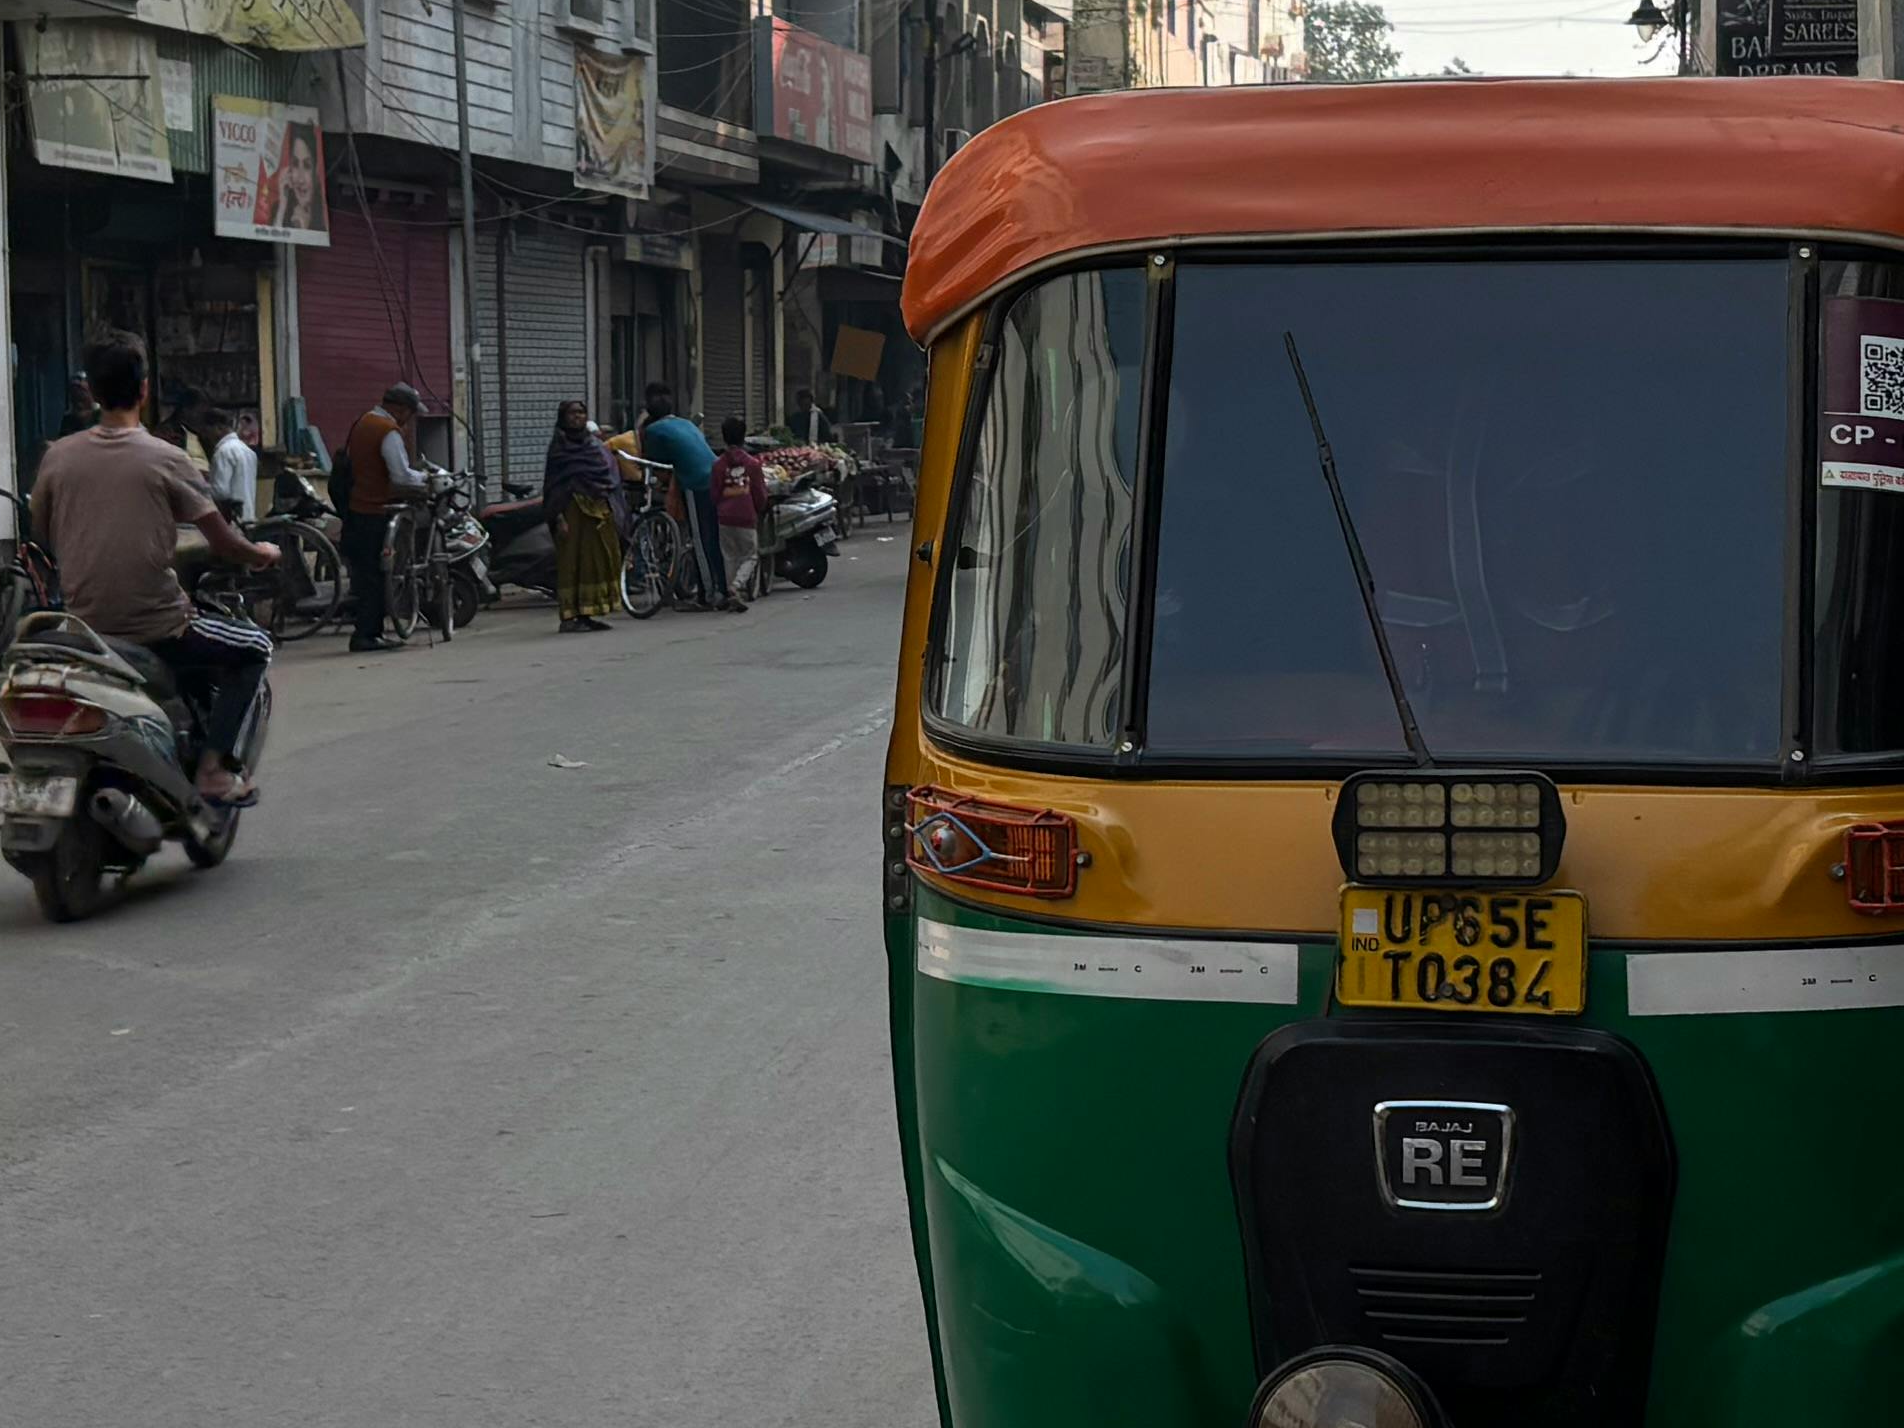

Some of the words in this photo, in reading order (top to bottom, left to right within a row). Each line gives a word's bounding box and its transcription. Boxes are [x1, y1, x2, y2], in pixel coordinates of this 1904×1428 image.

[1784, 23, 1856, 41] SAREES
[219, 120, 256, 143] VICCO
[1830, 424, 1875, 445] CP
[1383, 894, 1553, 951] UP65E
[1352, 938, 1379, 951] IND
[1382, 950, 1553, 1008] T0384
[1415, 1121, 1473, 1133] BAJAJ
[1401, 1137, 1487, 1186] RE
